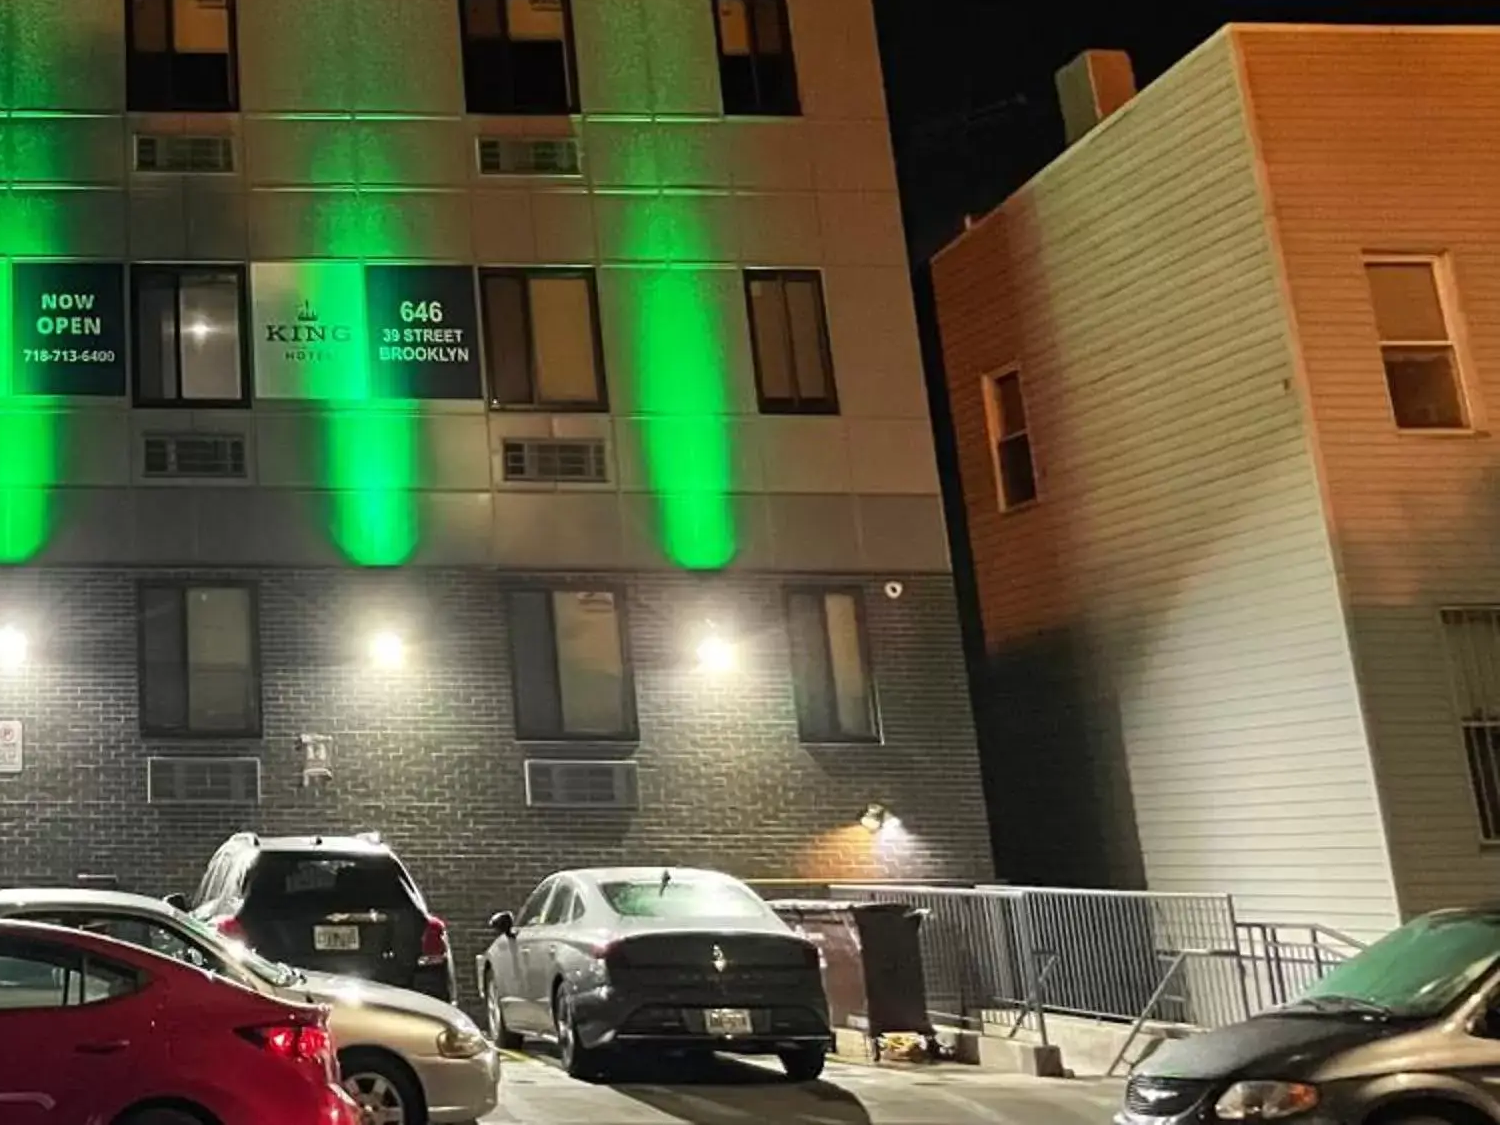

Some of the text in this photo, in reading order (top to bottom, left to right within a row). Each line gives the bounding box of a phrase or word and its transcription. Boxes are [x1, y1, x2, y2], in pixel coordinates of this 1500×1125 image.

[41, 293, 95, 310] NOW
[399, 300, 444, 323] 646
[36, 316, 102, 335] OPEN
[266, 325, 352, 342] KING
[382, 328, 464, 343] 39 STREET
[22, 349, 116, 363] 718-713-6400
[379, 346, 470, 362] BROOKLYN
